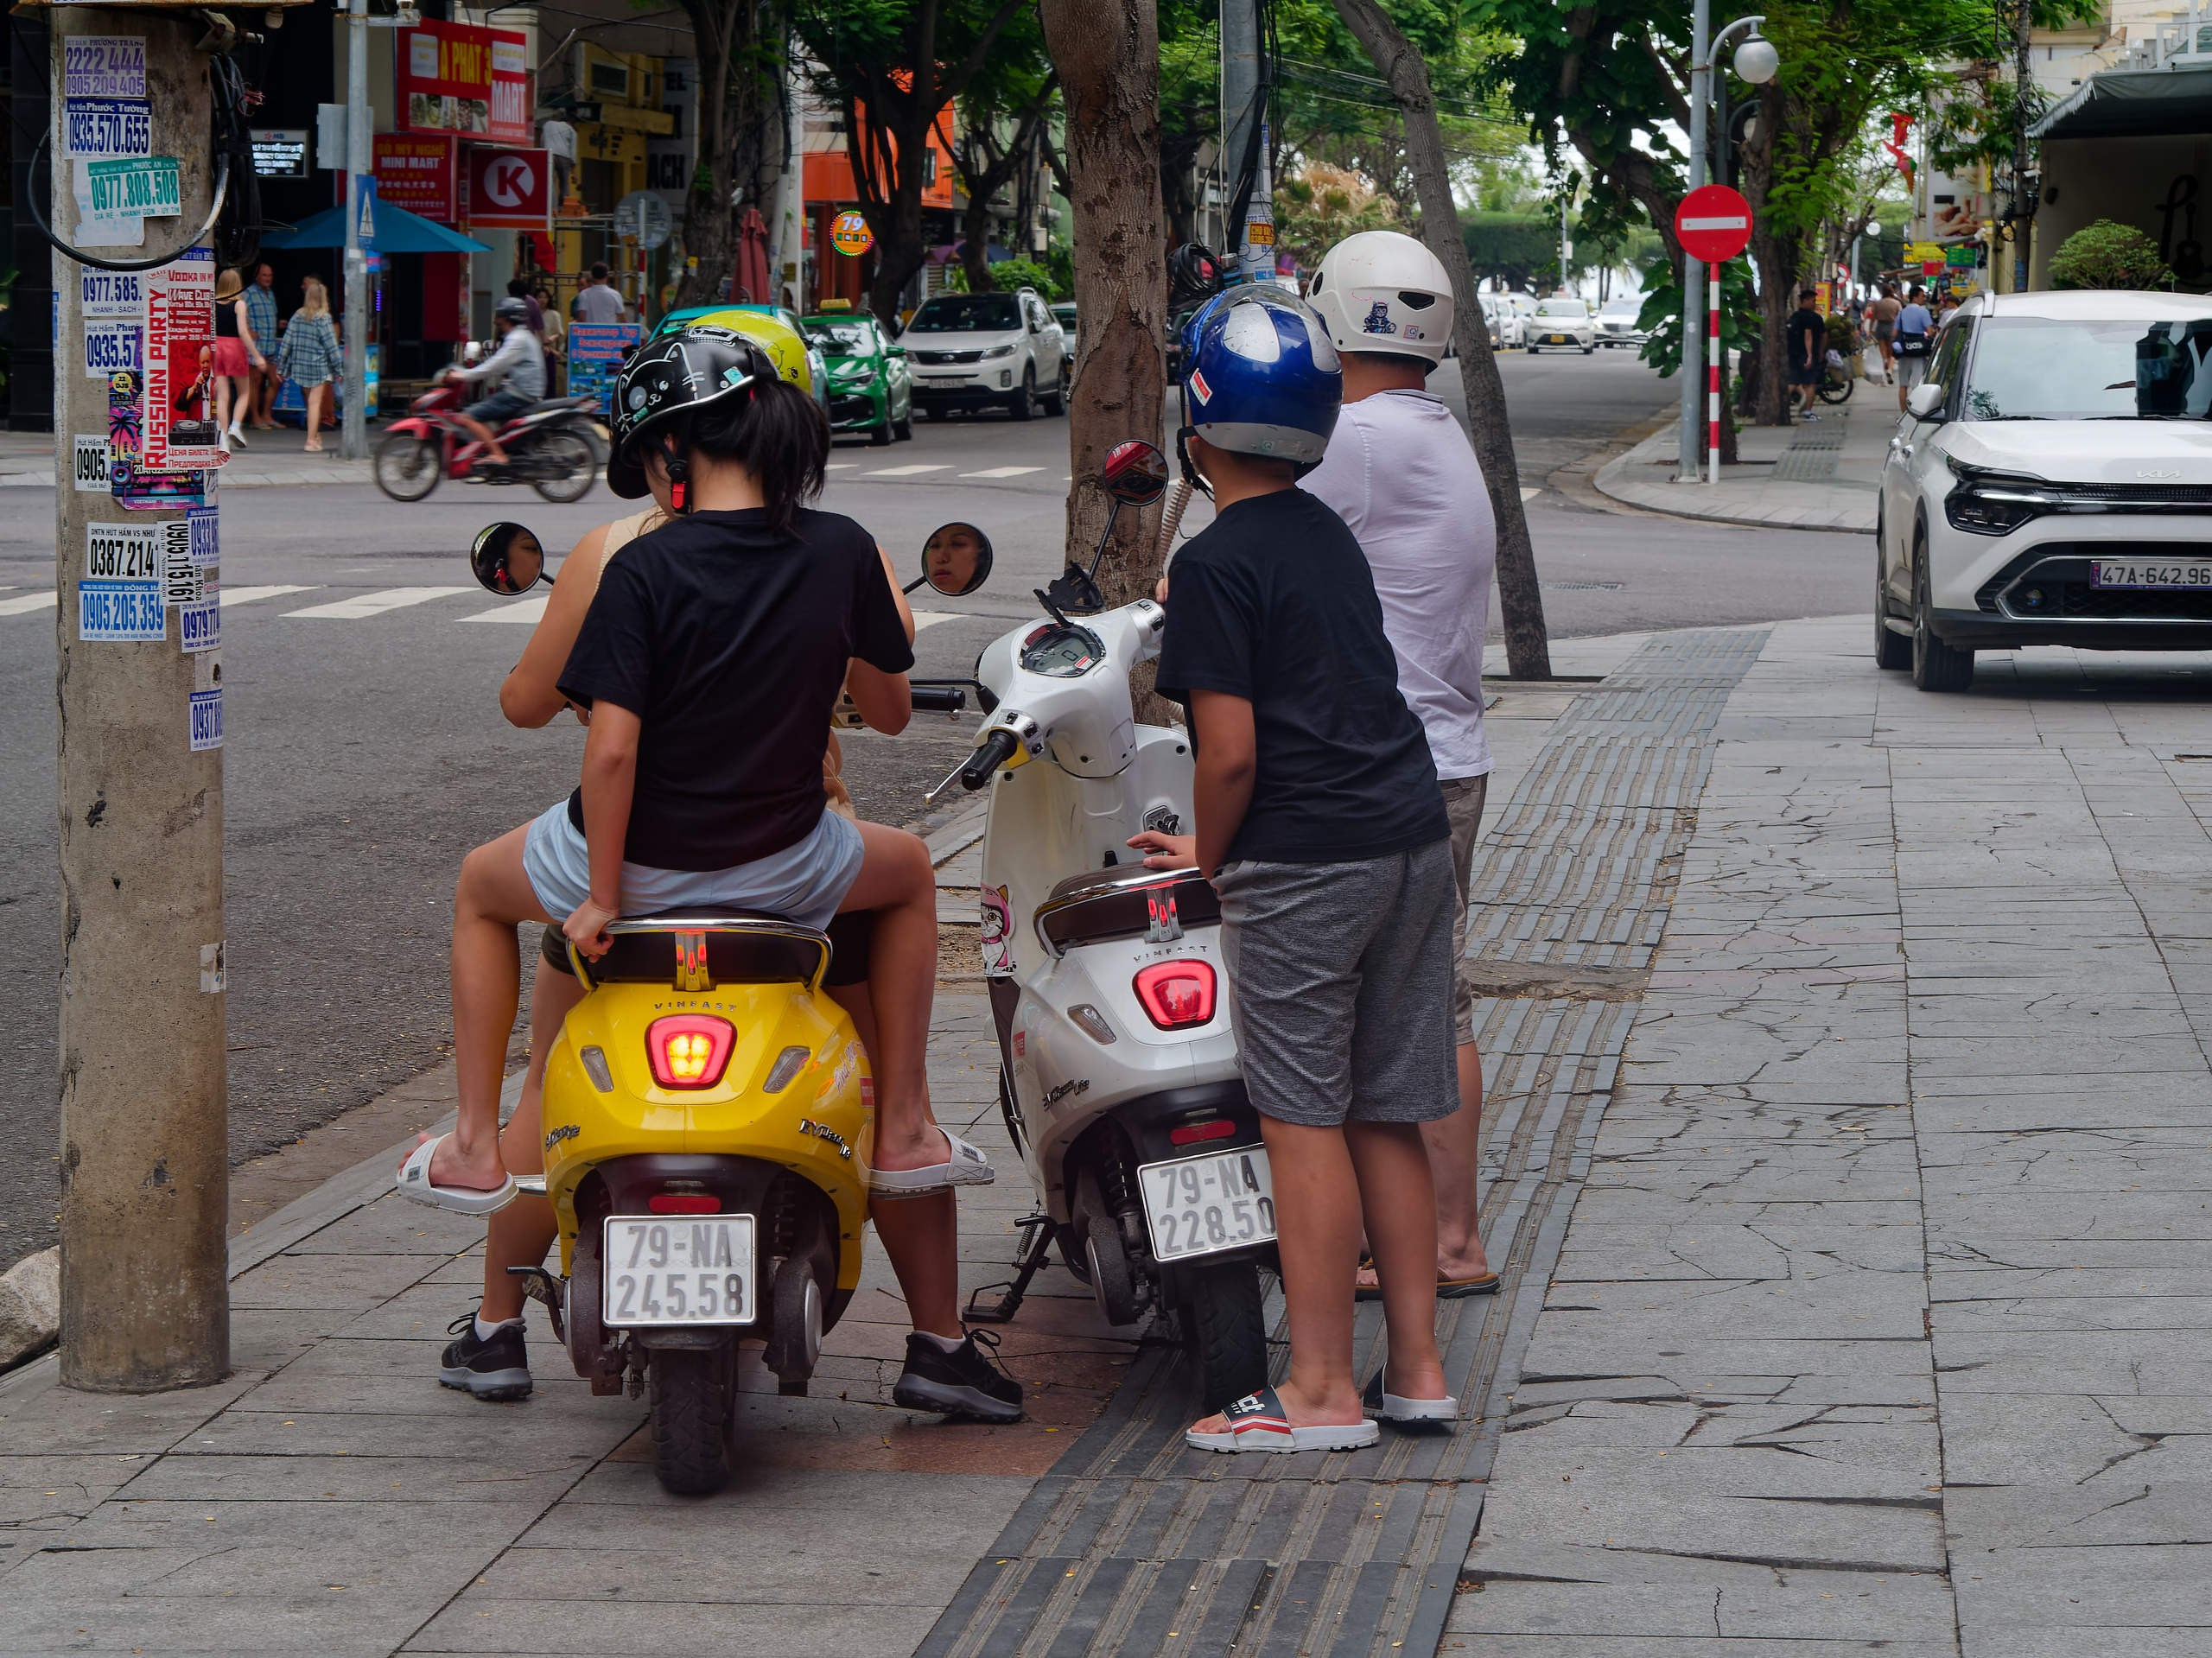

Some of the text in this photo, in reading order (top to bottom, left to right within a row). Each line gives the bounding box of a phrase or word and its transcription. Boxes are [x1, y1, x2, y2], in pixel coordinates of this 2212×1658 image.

[67, 47, 144, 75] 2222.444
[492, 79, 526, 124] MART
[70, 113, 149, 154] 0935.570.655
[409, 156, 440, 169] MART
[92, 171, 178, 211] 0977.808.508
[842, 215, 864, 232] 79
[144, 289, 167, 467] RUSSIAN PARTY
[167, 523, 195, 603] 0905.115.161
[2101, 567, 2211, 585] 47A-642.96
[83, 593, 163, 631] 0905.205.359
[1133, 945, 1208, 963] VINFAST
[654, 1001, 737, 1013] VINFAST
[1159, 1154, 1260, 1210] 79-NA
[1159, 1196, 1277, 1254] 228.50
[626, 1223, 733, 1269] 79-NA
[615, 1273, 744, 1319] 245.58
